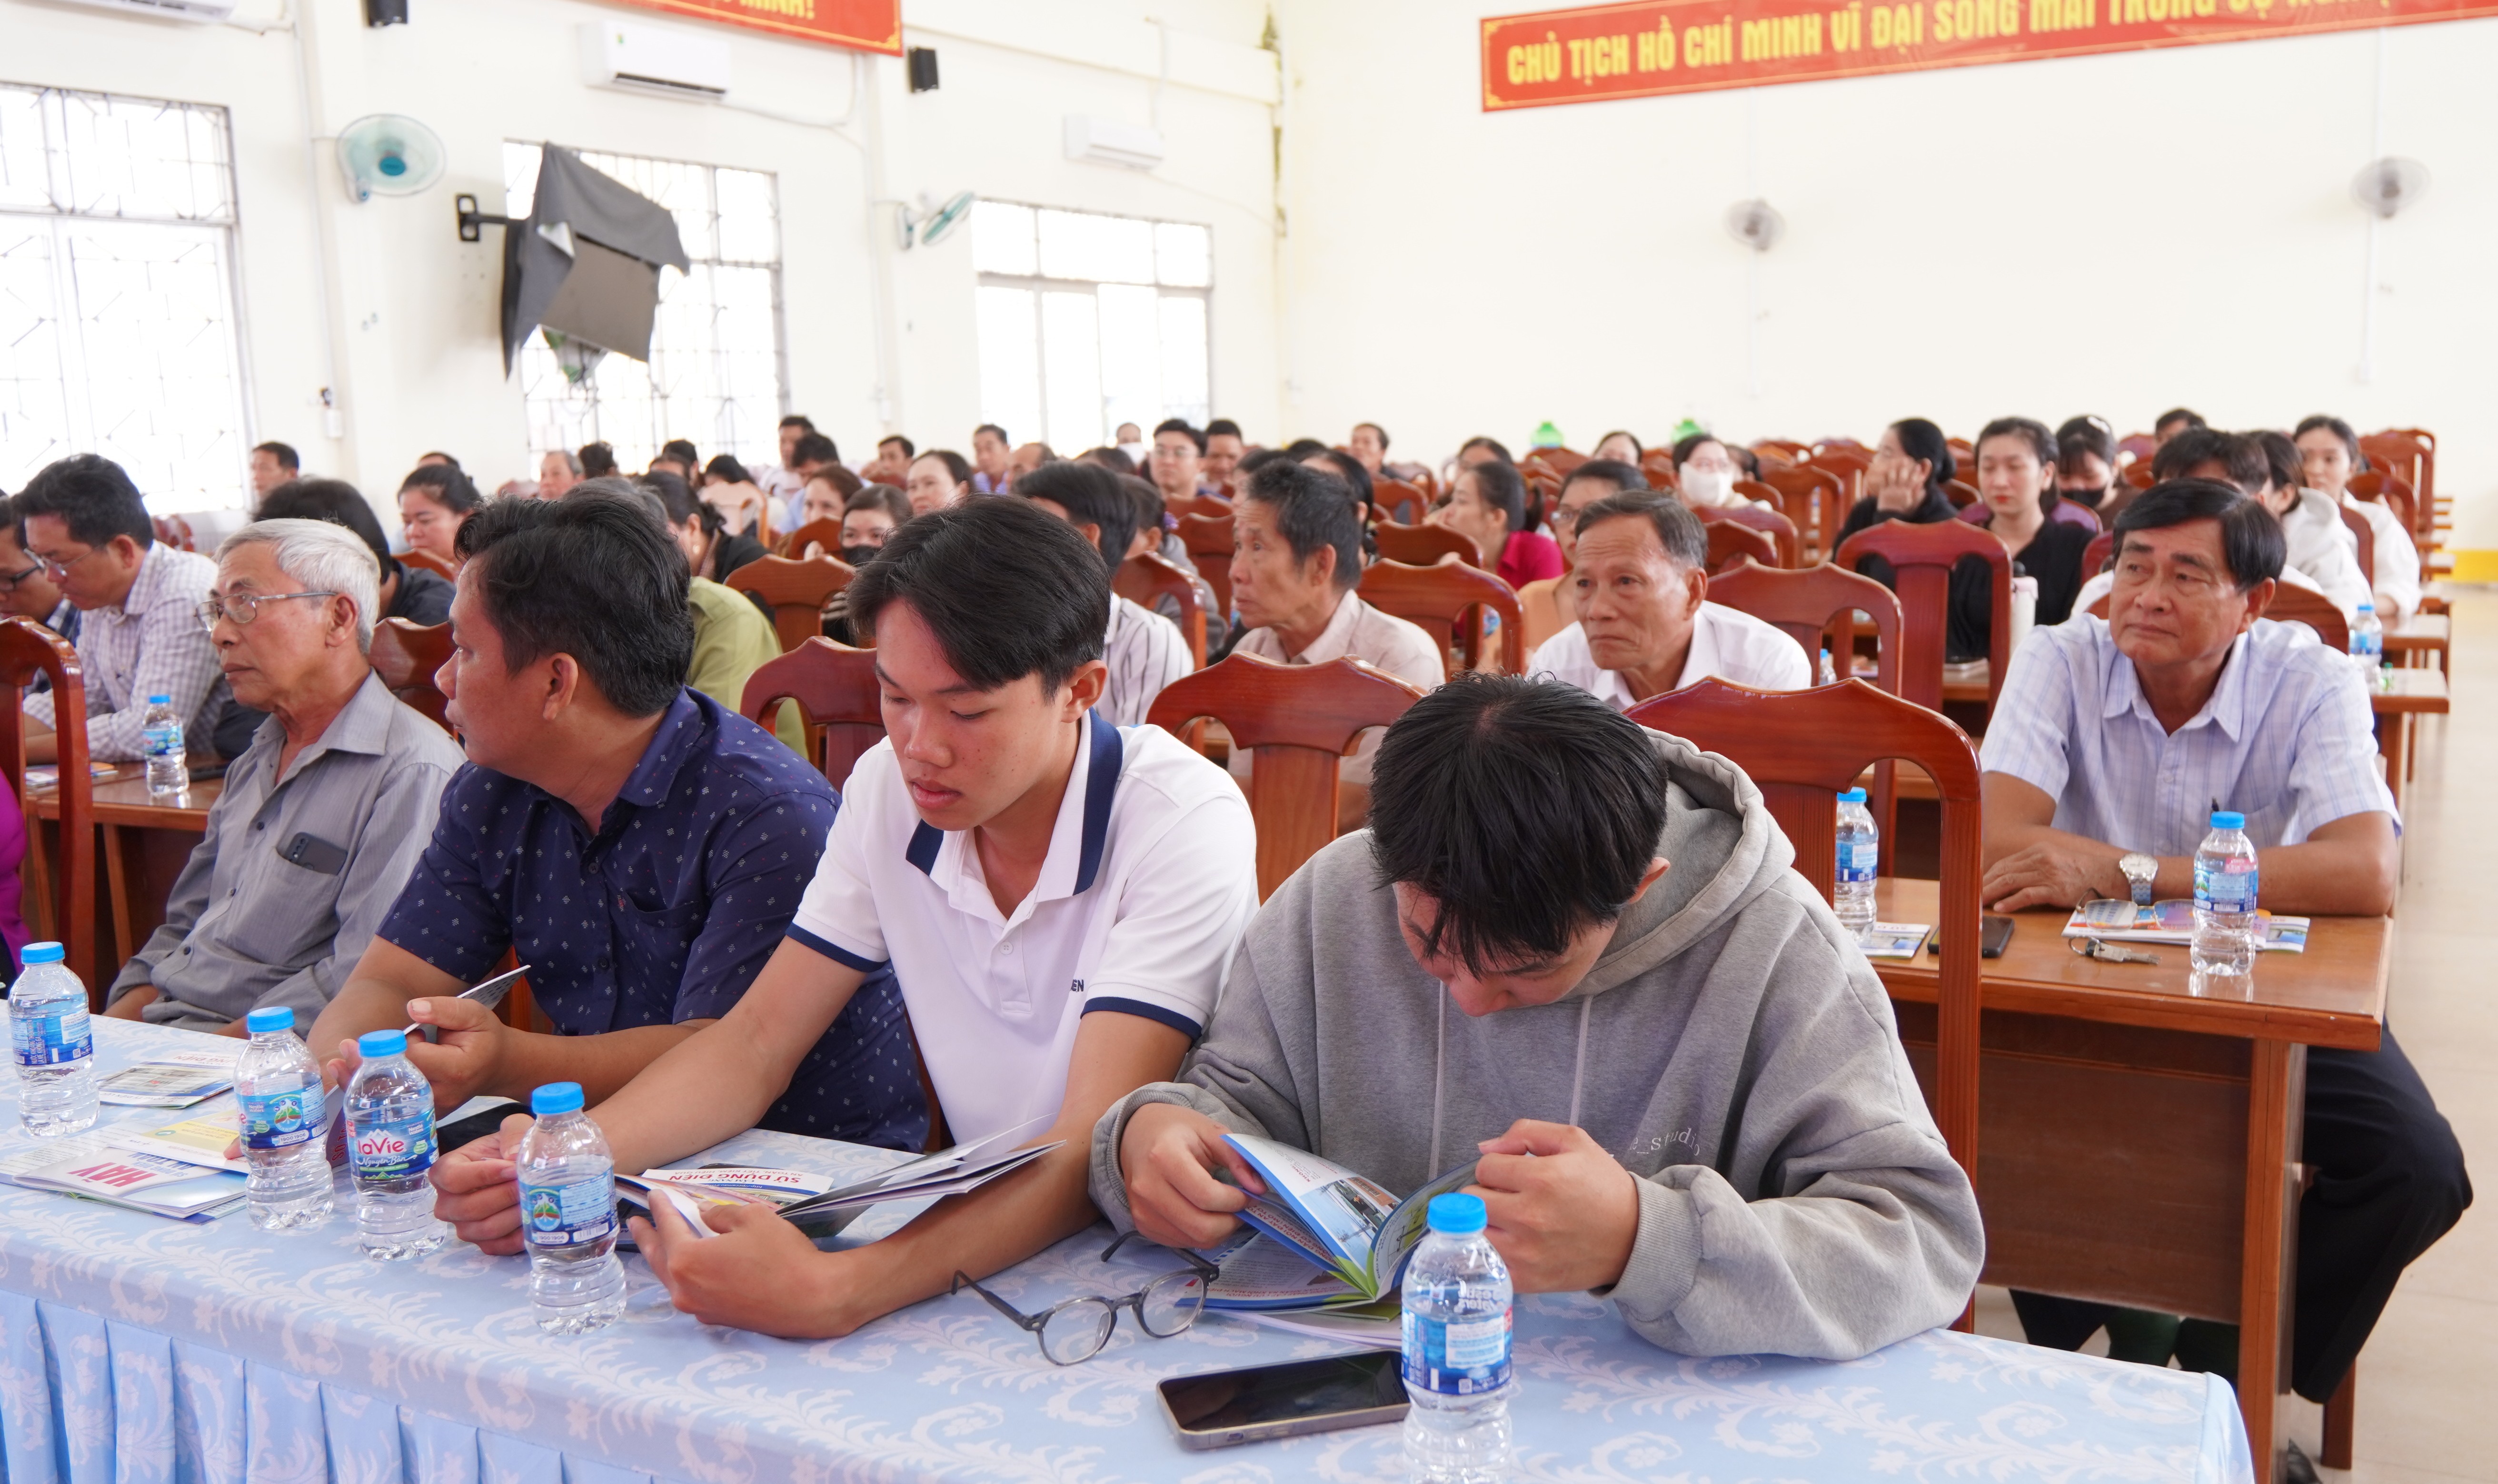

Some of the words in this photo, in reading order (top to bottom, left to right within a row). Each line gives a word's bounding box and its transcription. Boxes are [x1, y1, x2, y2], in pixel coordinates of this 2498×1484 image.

[1507, 31, 1562, 85] CHỦ
[1568, 34, 1631, 86] TỊCH
[1637, 15, 1677, 73] HỒ
[1683, 15, 1733, 68] CHÍ
[1741, 13, 1823, 62] MINH
[1870, 3, 1924, 54] ĐẠI
[358, 1137, 405, 1155] laVie
[67, 1162, 159, 1187] HÃY
